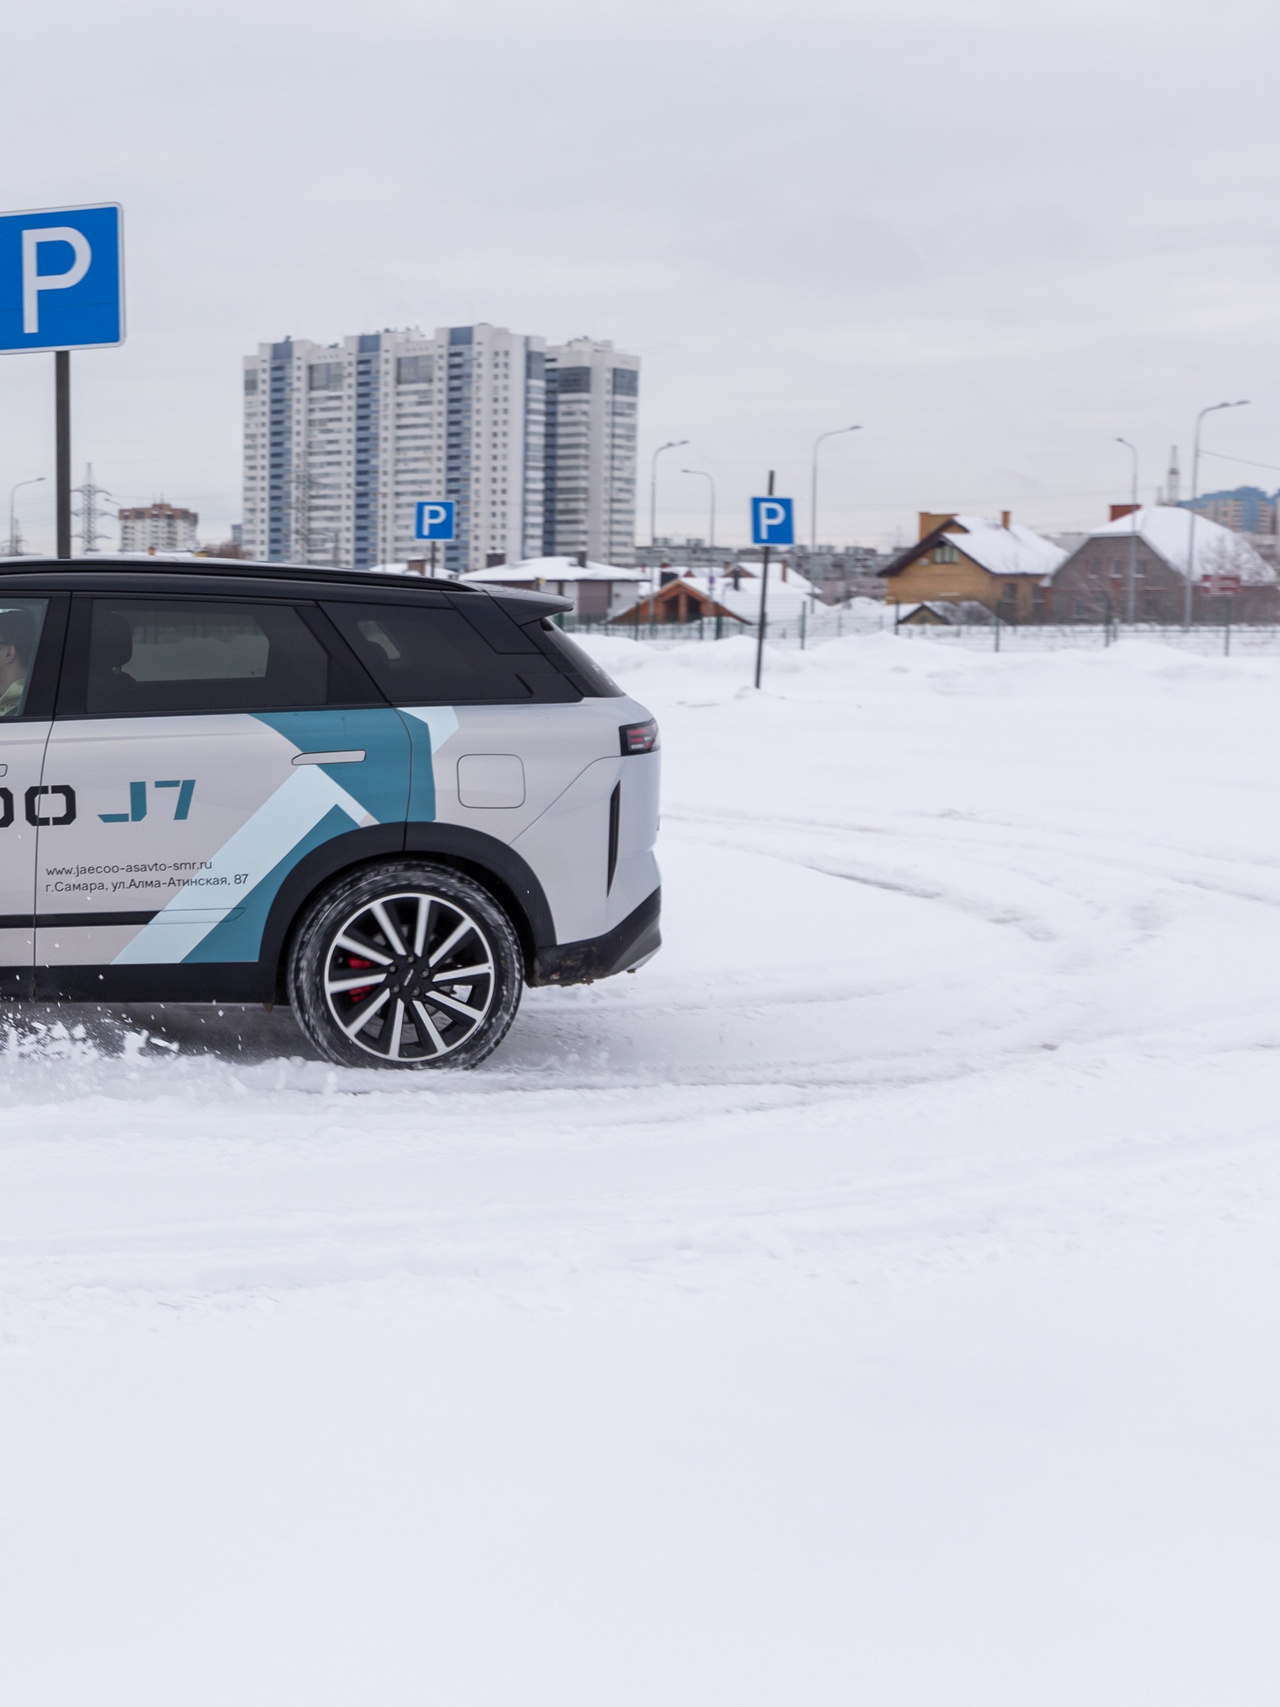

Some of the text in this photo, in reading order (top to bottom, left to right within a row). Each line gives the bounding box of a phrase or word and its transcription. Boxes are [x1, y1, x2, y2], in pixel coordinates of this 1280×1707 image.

[22, 226, 91, 334] P
[422, 506, 446, 535] P
[760, 503, 785, 539] P
[97, 779, 196, 823] J7
[45, 873, 249, 893] г.Самара, ул.Алма-Атинская, 87
[46, 861, 213, 877] www.jaecoo-asavto-smr.ru
